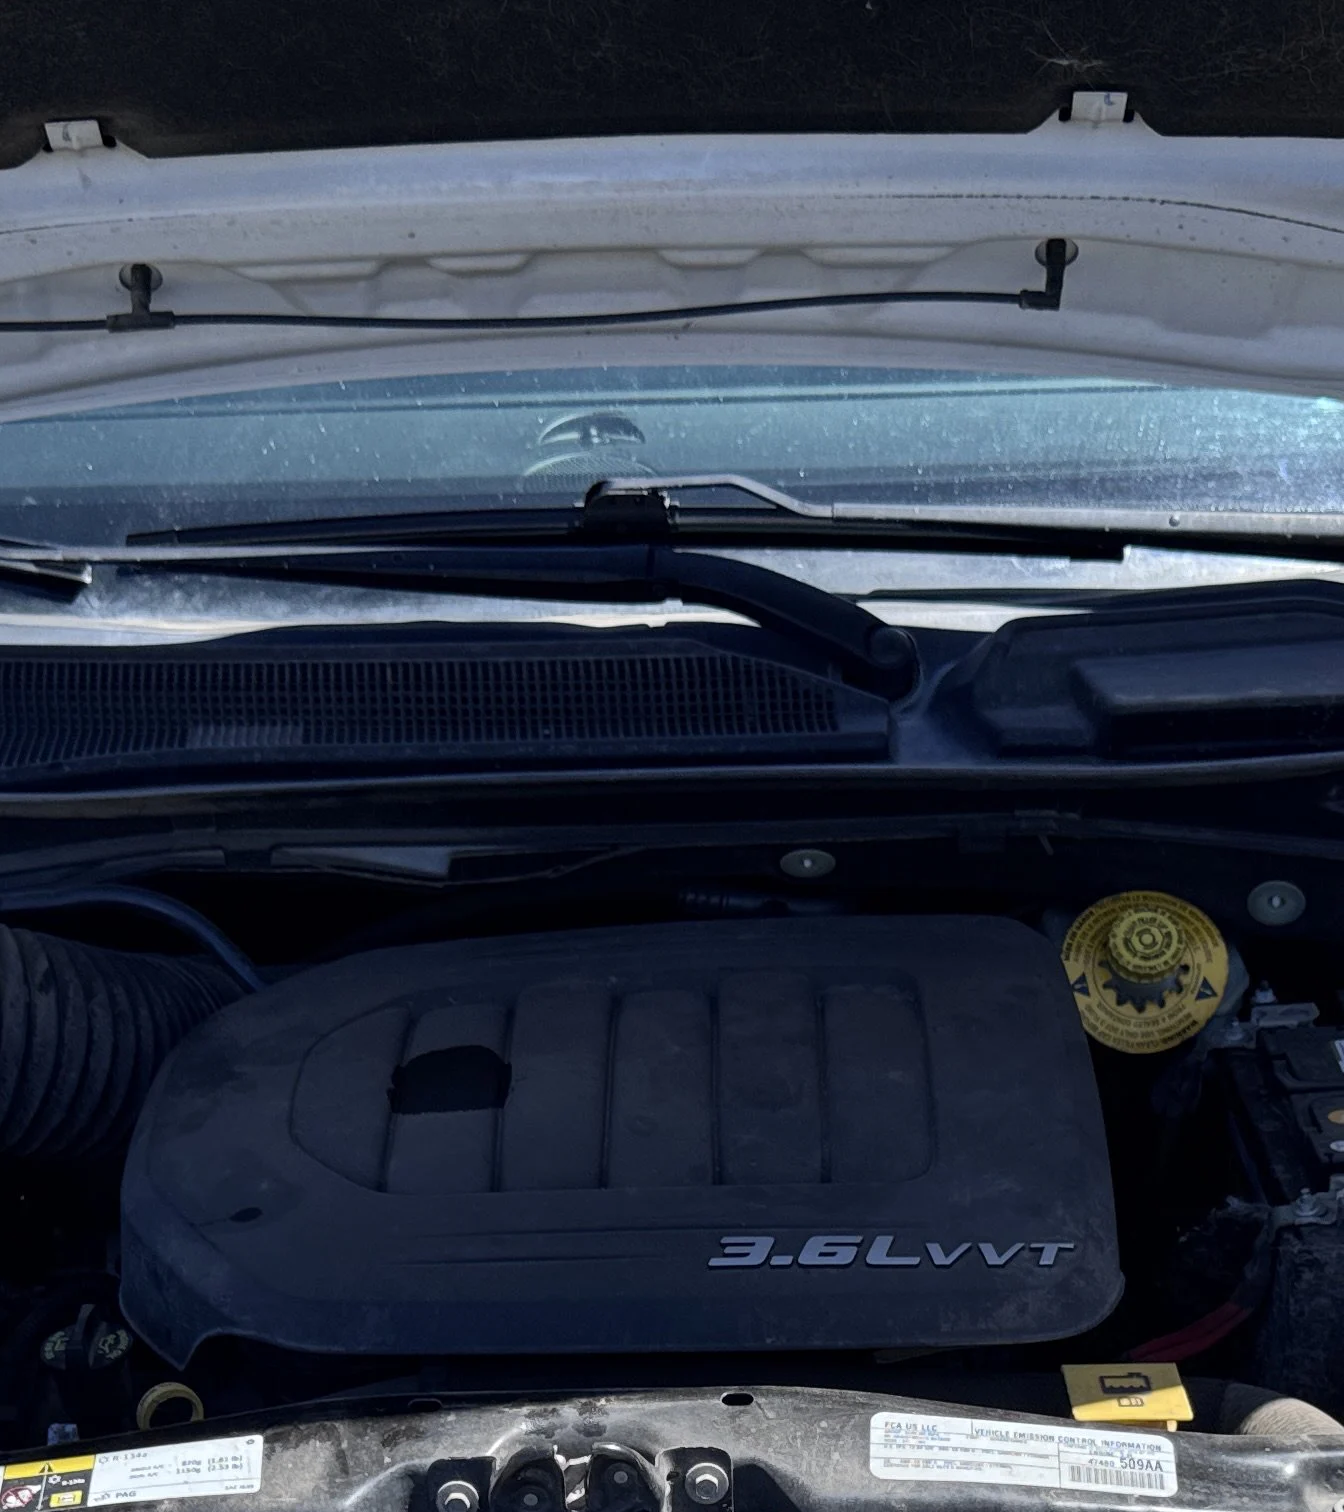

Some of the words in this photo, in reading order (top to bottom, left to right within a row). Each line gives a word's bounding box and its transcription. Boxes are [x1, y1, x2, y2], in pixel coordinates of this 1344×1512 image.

[884, 1421, 903, 1430] FCA
[921, 1423, 938, 1432] LLC
[974, 1429, 1010, 1439] VEHICLE
[1013, 1431, 1055, 1443] EMISSION
[1057, 1435, 1097, 1447] CONTROL
[1100, 1439, 1162, 1452] INFORMATION
